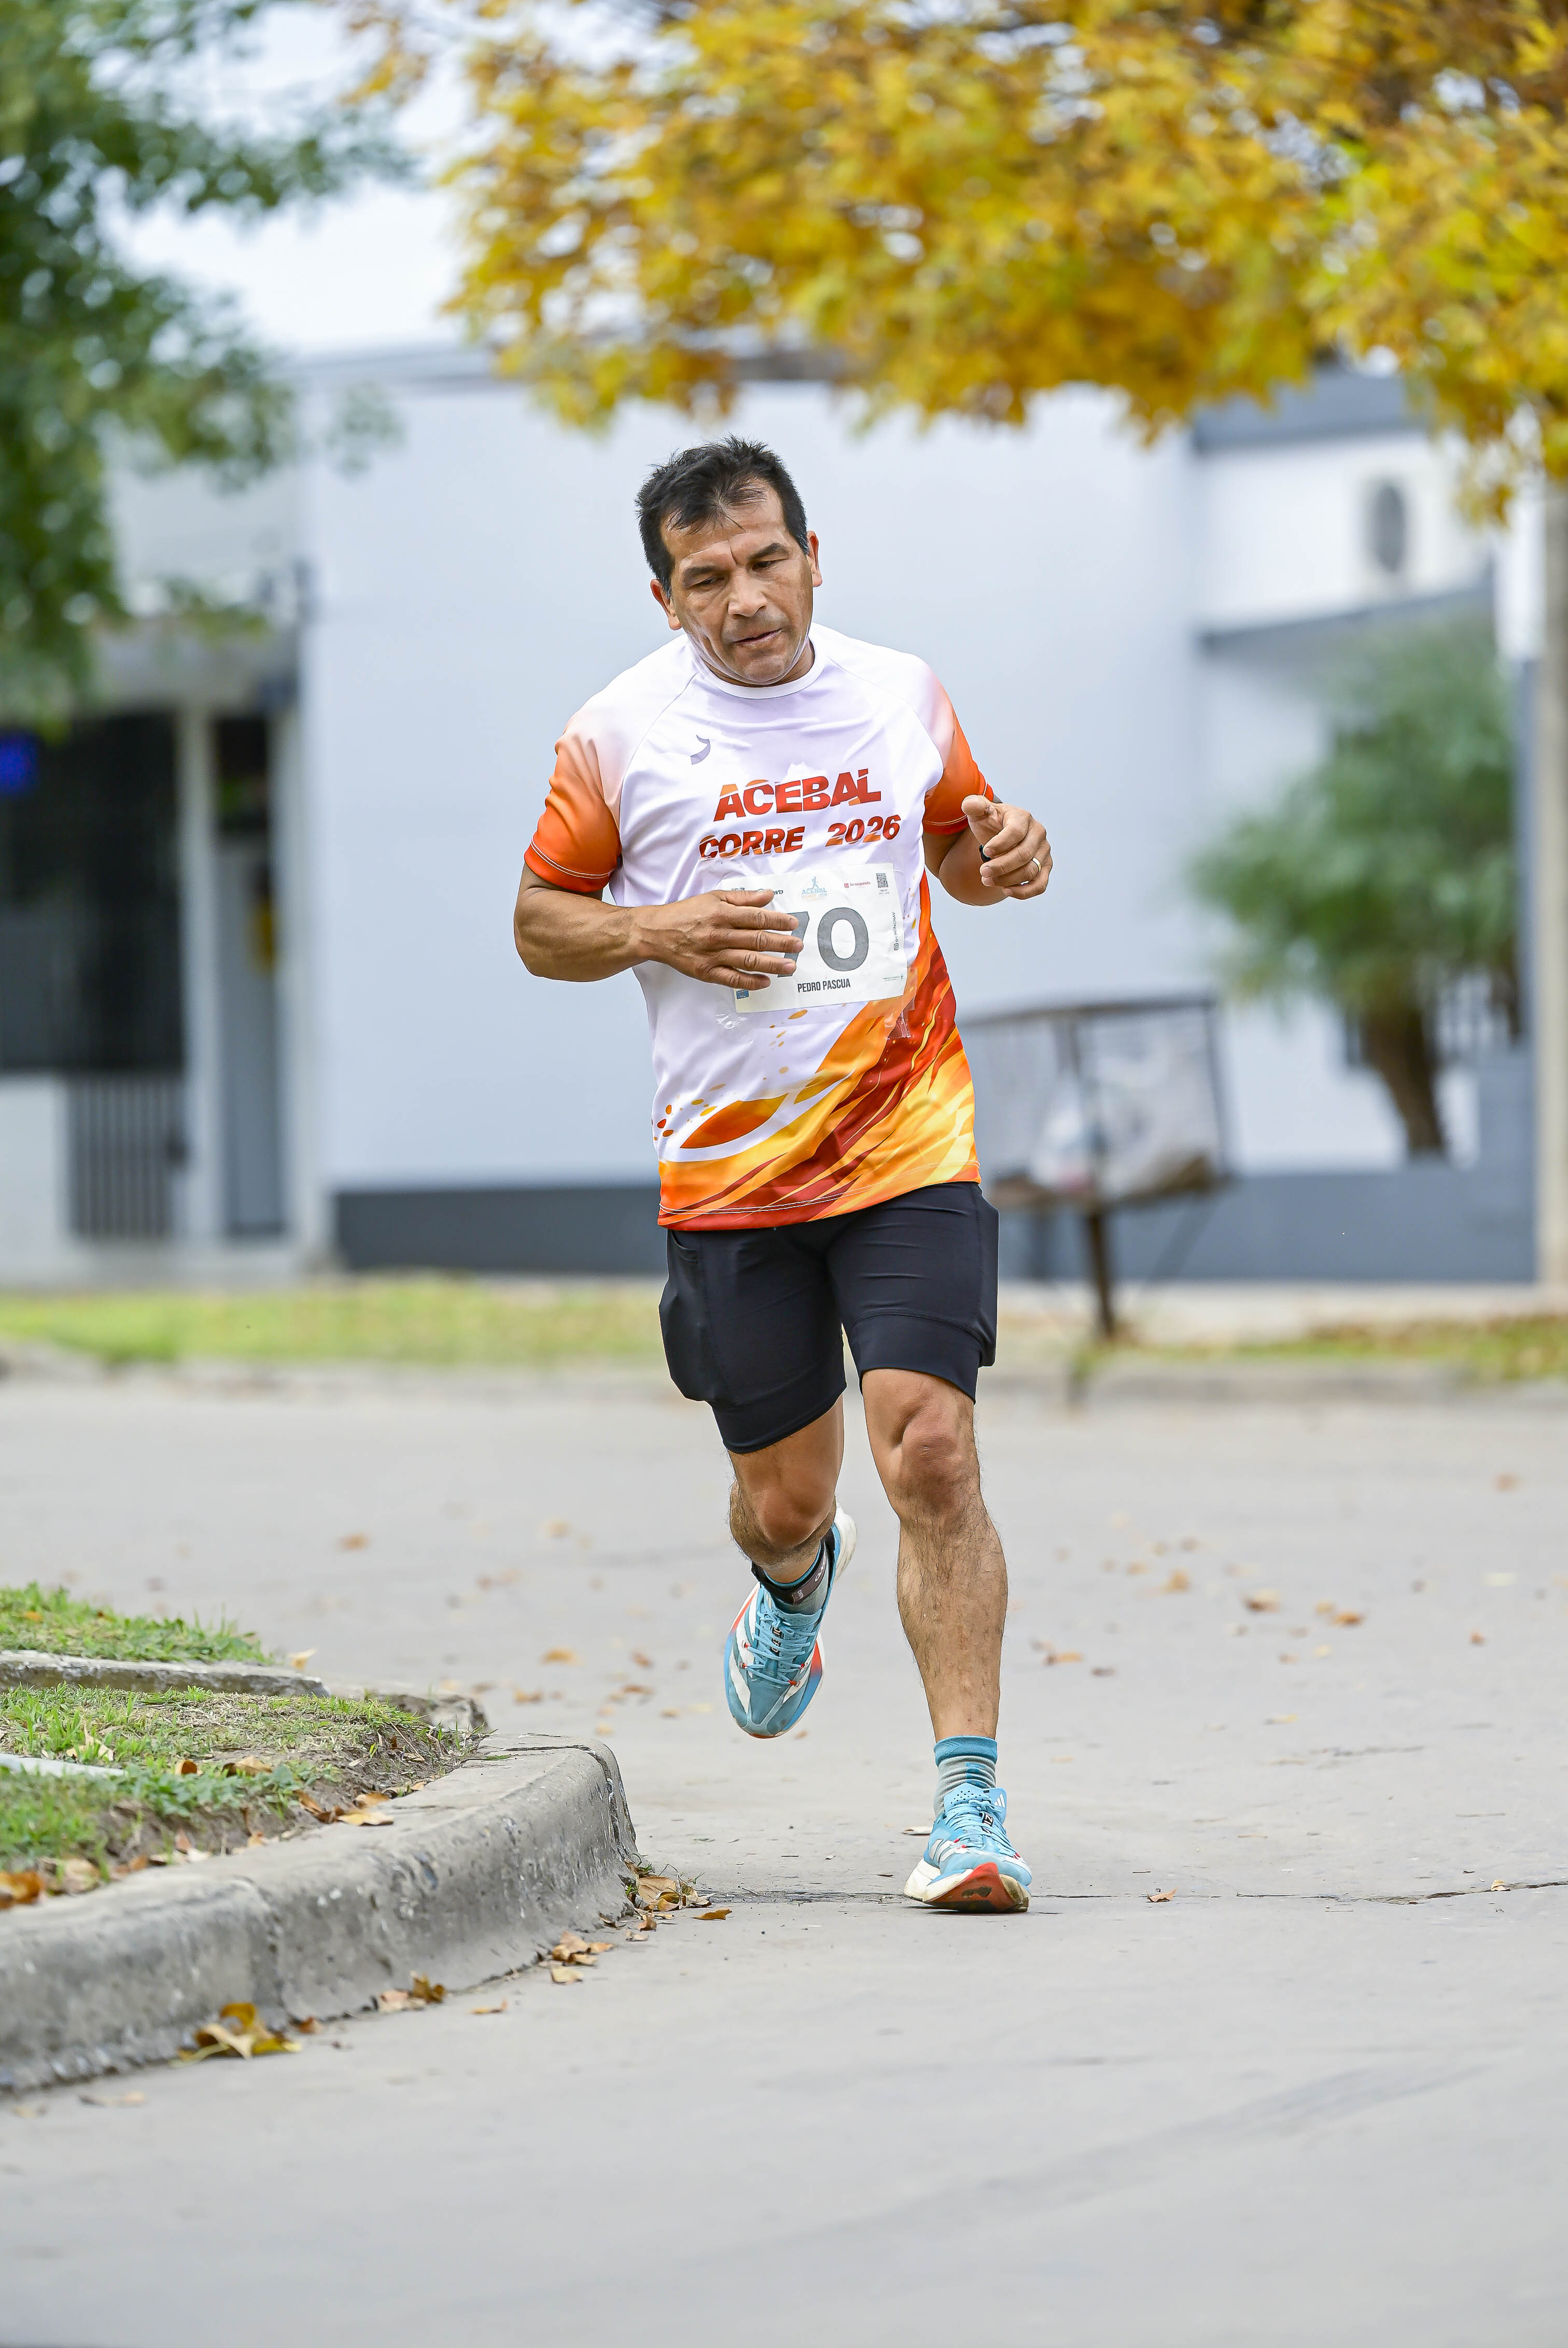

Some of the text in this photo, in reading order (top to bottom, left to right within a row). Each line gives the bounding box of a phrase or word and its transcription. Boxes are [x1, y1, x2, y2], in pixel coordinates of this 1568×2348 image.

[713, 768, 881, 821] ACEBAL
[699, 814, 901, 859] CORRE 2026
[797, 978, 851, 993] PEDRO PASCUA
